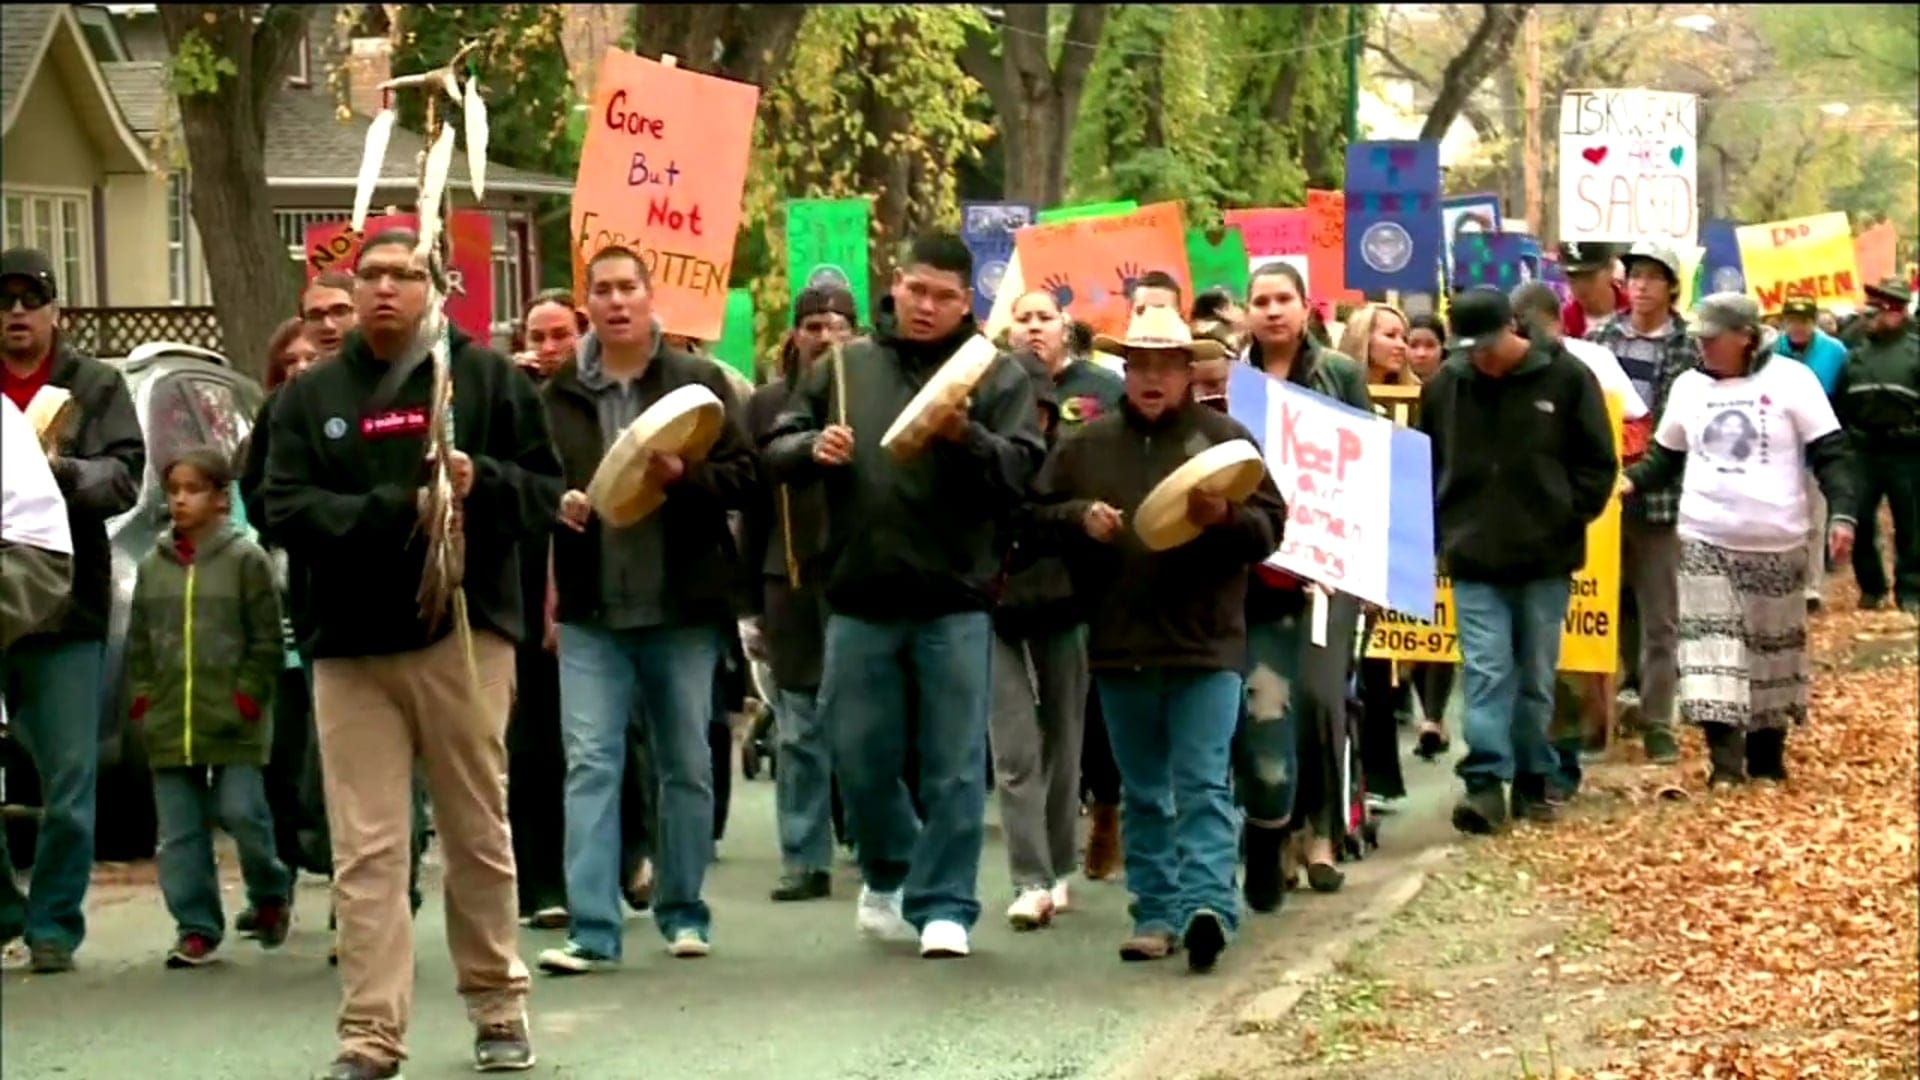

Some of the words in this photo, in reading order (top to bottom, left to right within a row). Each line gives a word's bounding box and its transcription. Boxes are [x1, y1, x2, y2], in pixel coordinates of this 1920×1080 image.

[605, 89, 665, 139] Gone
[628, 152, 681, 186] But
[647, 198, 703, 236] Not
[1771, 224, 1811, 247] END
[1755, 270, 1855, 311] WOMEN
[1373, 628, 1457, 654] 306-97
